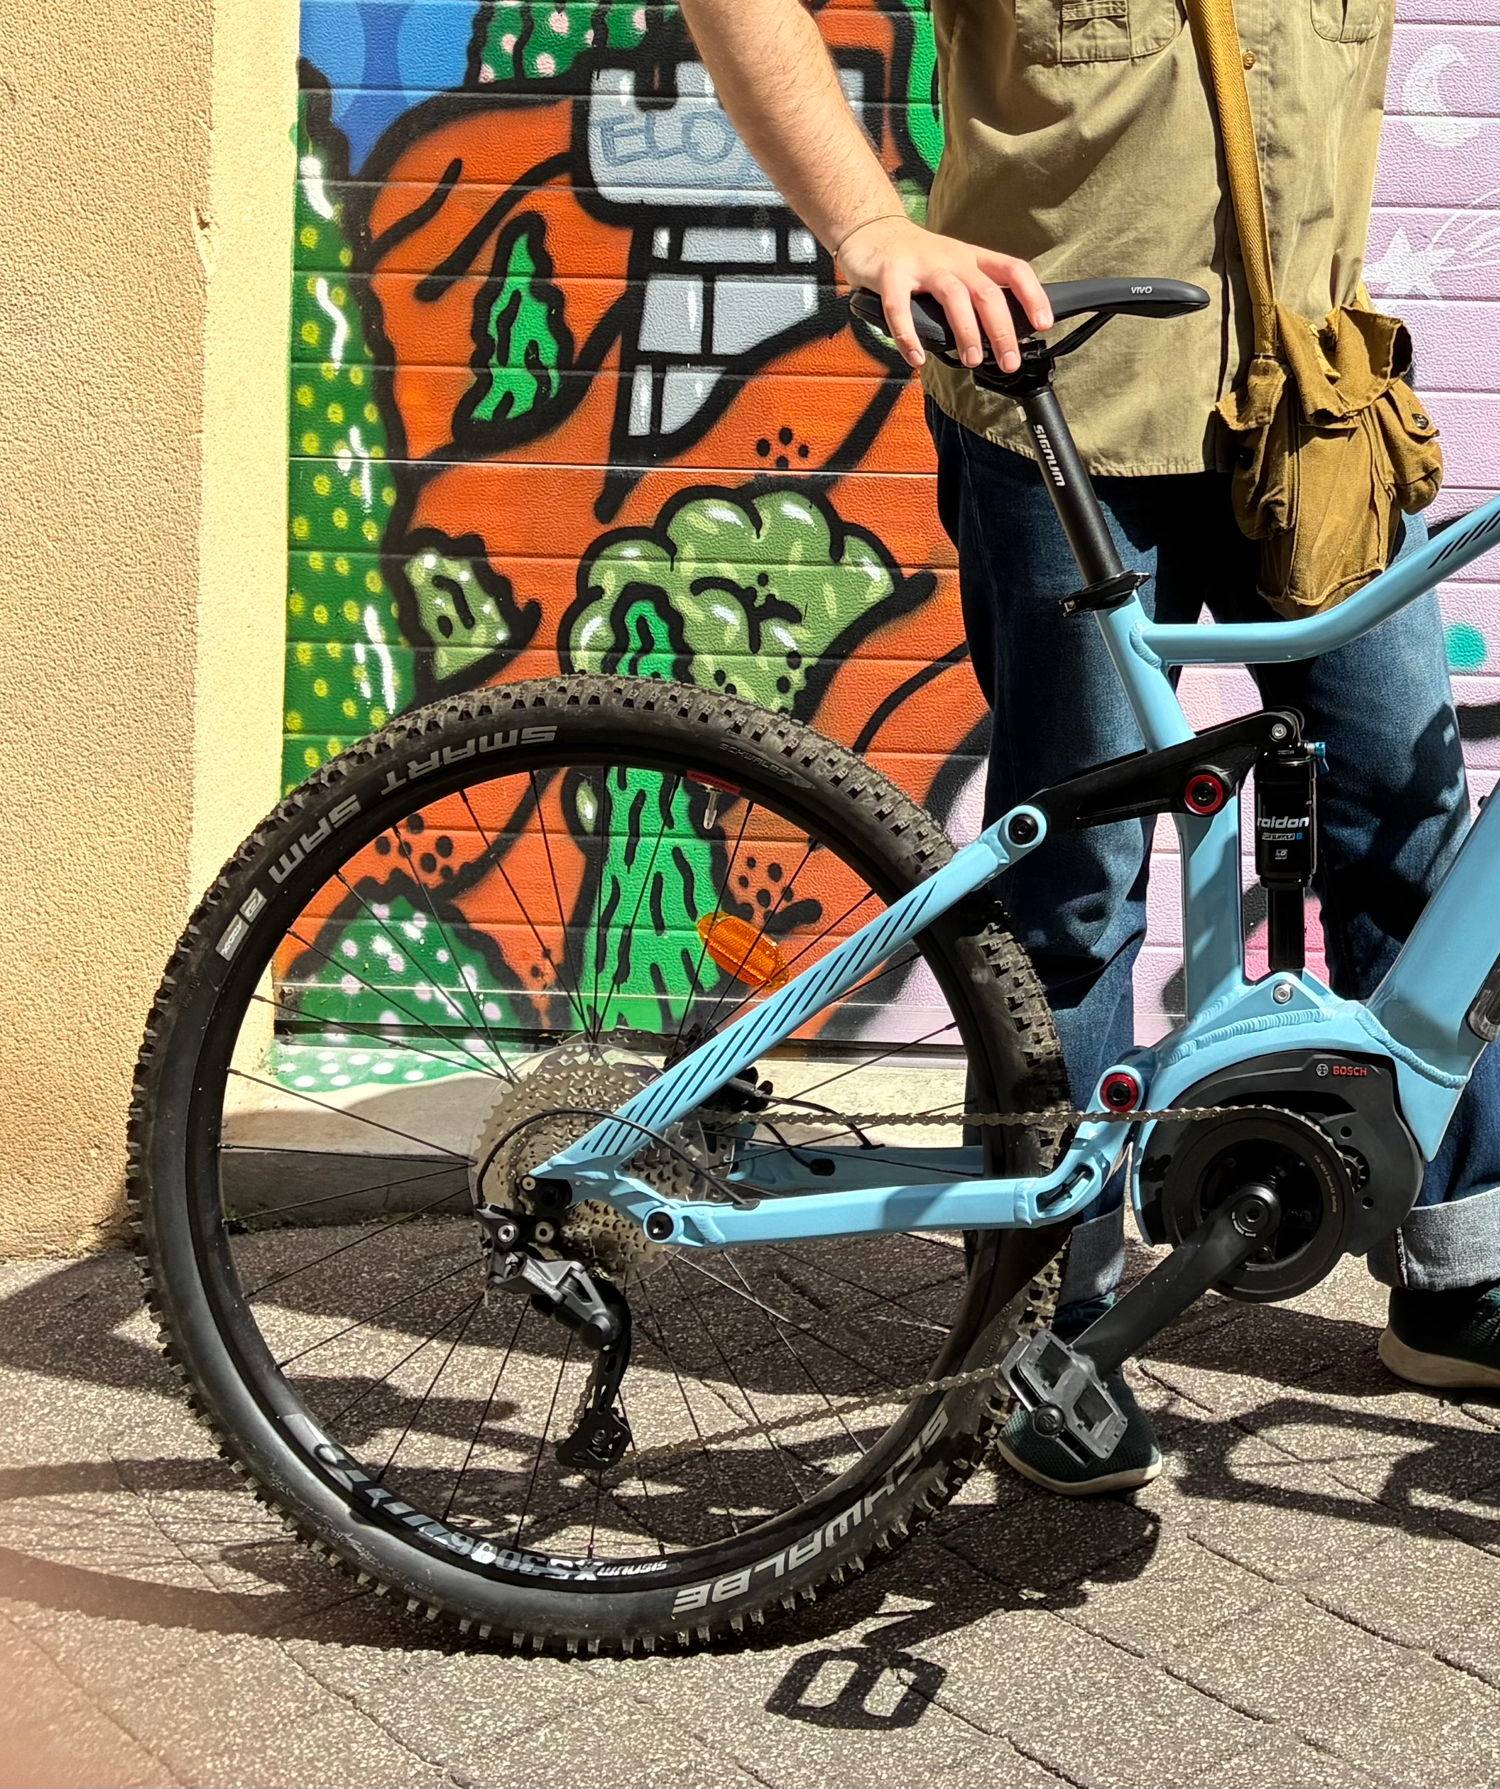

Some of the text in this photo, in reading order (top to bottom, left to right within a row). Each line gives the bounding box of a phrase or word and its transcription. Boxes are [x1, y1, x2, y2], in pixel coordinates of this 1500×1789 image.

[1130, 285, 1153, 294] VIVO
[268, 725, 558, 885] SMART SAM
[1332, 1065, 1367, 1077] BOSCH
[671, 1408, 949, 1614] SCHWALBE
